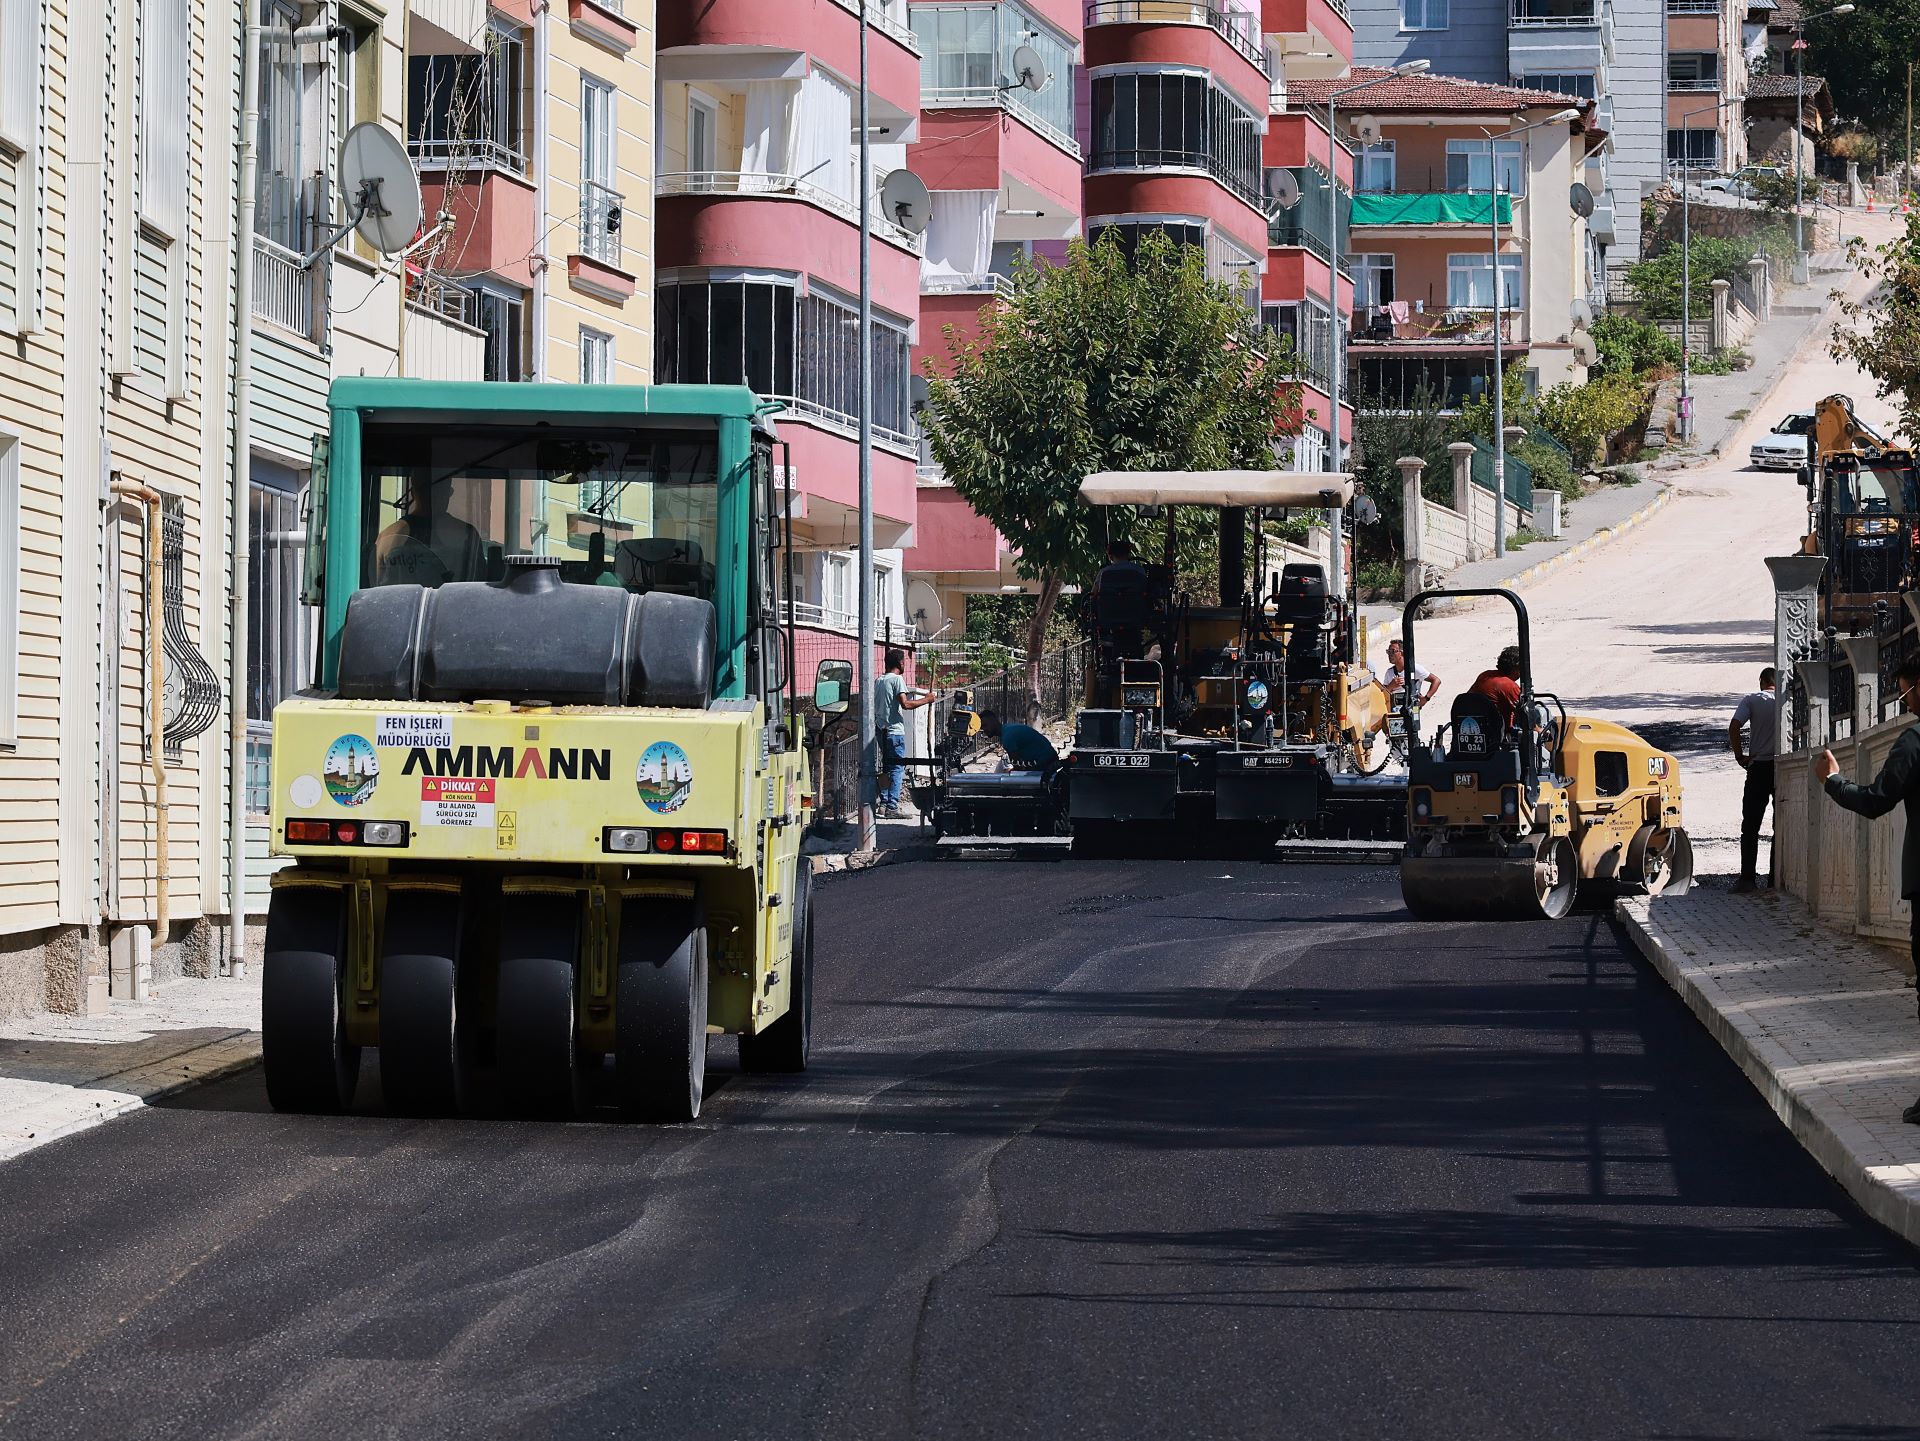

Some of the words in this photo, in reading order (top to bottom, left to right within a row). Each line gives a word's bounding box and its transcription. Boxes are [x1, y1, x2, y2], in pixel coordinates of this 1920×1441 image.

[386, 717, 406, 729] FEN
[410, 715, 443, 733] İŞLERİ
[377, 732, 451, 747] MÜDÜRLÜĞÜ
[1460, 735, 1469, 743] 60
[1473, 735, 1484, 744] 23
[1467, 743, 1482, 752] 034
[401, 745, 611, 780] AMMANN
[1099, 756, 1112, 766] 60
[1130, 756, 1149, 766] 022
[1244, 757, 1259, 767] CAT
[1648, 757, 1665, 775] CAT
[440, 779, 476, 792] DİKKAT
[1455, 774, 1472, 786] CAT
[435, 809, 463, 818] SÜRÜCÜ
[440, 818, 473, 826] GÖREMEZ
